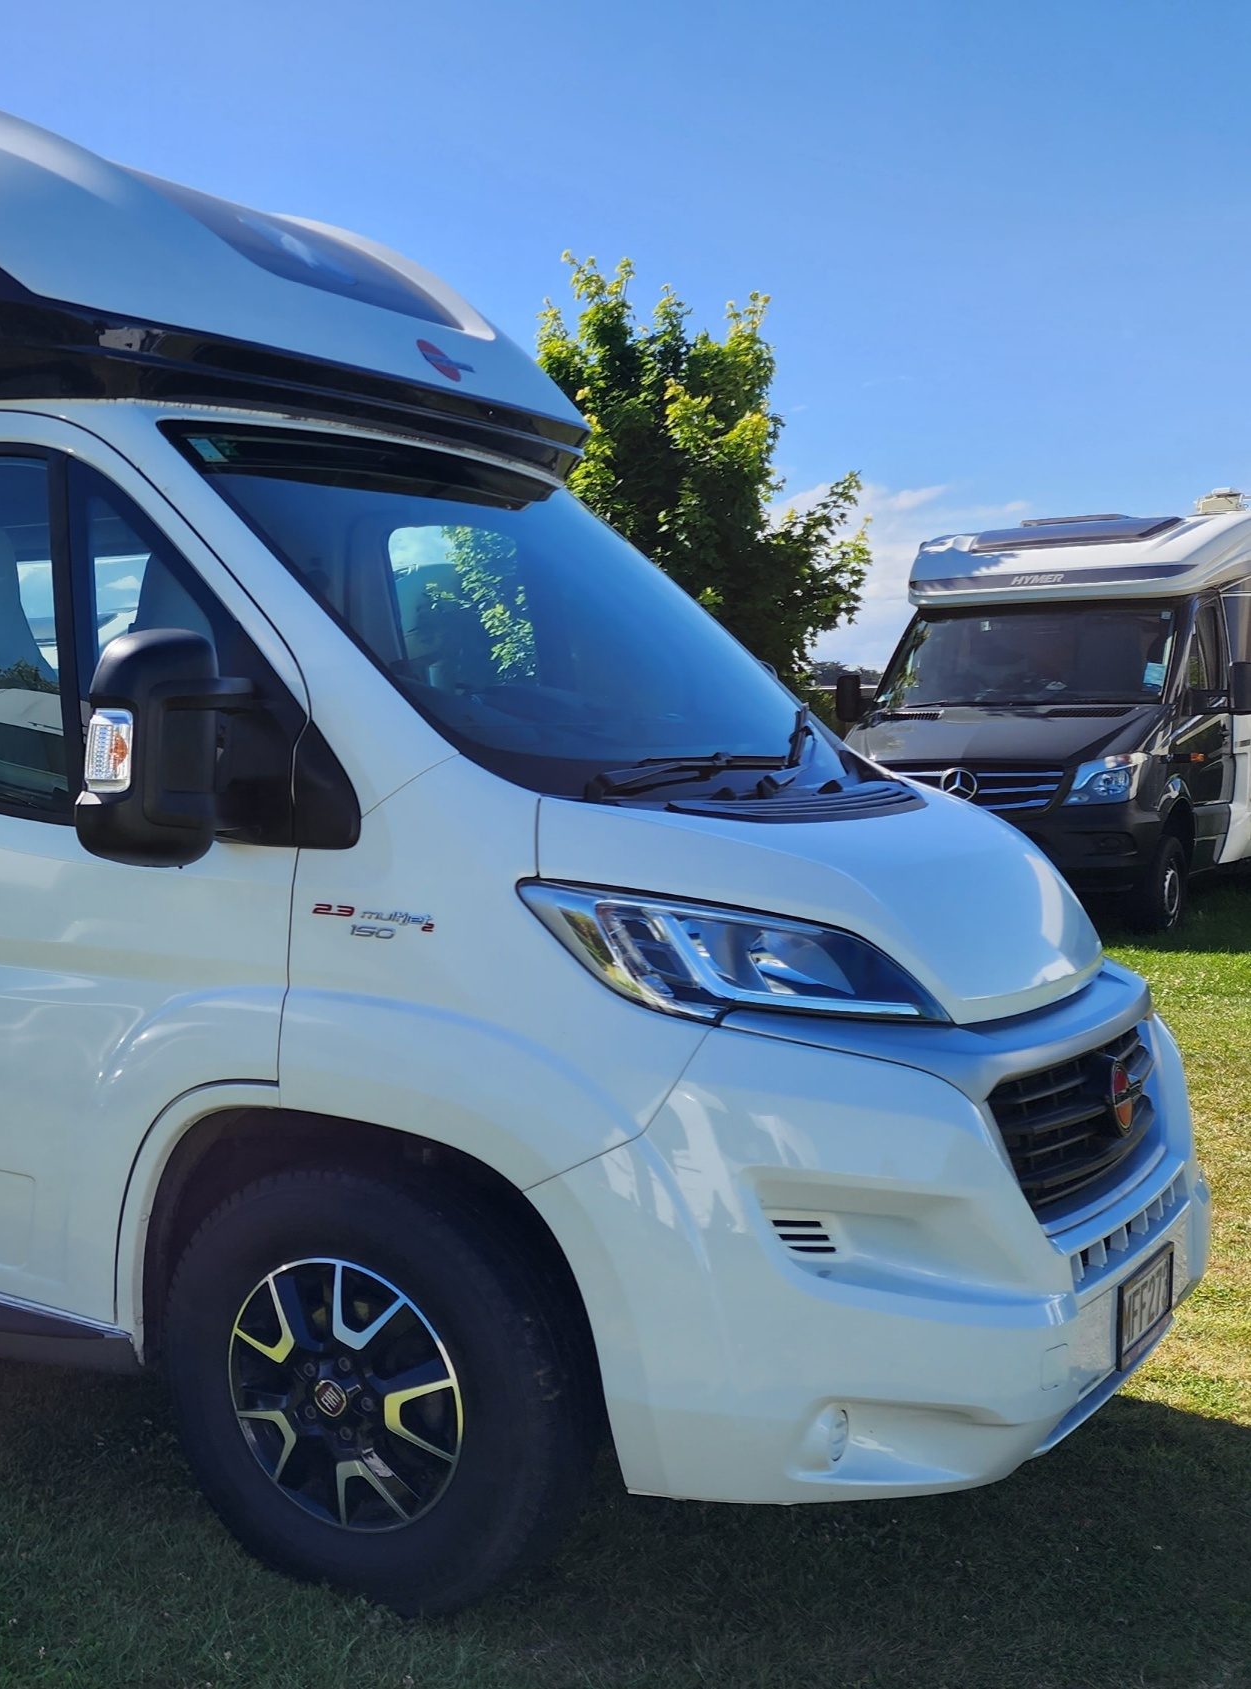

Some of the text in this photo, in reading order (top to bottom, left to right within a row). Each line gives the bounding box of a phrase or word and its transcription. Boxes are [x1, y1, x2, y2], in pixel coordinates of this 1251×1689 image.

[1011, 574, 1065, 586] HYMER
[350, 924, 396, 940] 150
[320, 1386, 341, 1411] FIAT
